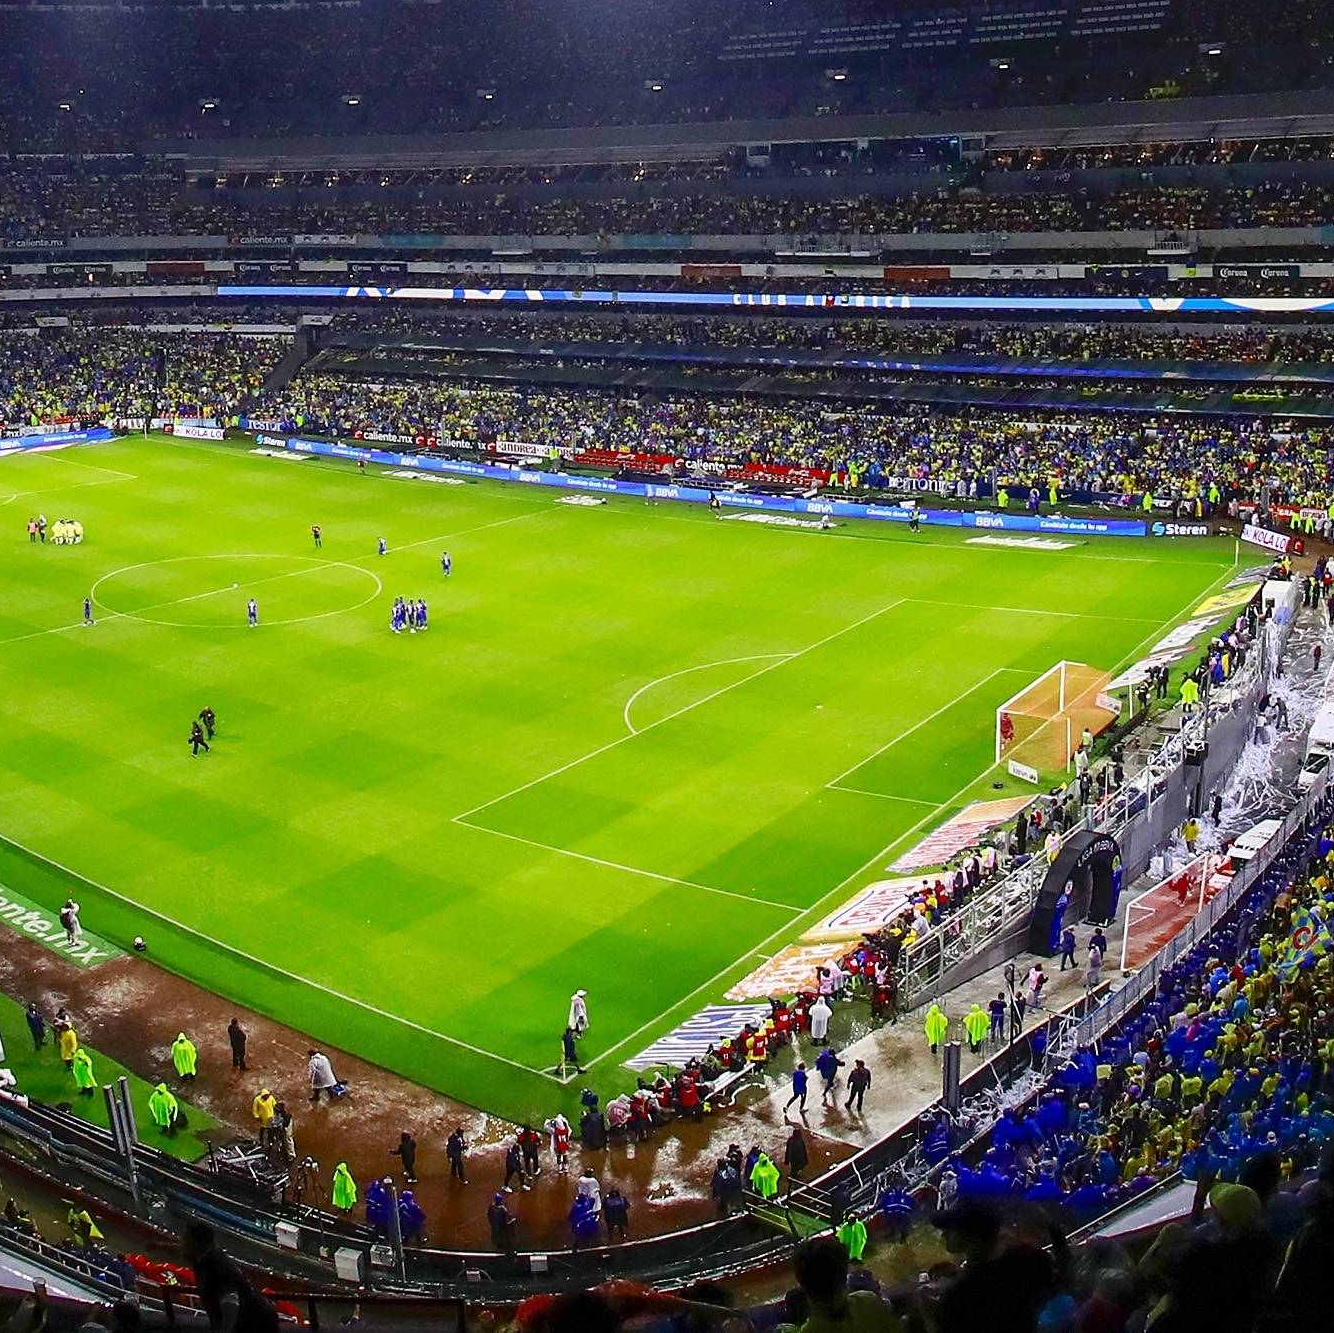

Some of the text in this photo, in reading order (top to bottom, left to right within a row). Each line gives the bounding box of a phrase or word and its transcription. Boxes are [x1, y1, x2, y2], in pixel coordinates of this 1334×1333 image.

[1219, 267, 1290, 279] Corona Corona
[733, 294, 788, 307] CLUB
[363, 432, 413, 445] caliente.mx
[519, 473, 541, 483] BBVA
[655, 487, 678, 498] BBVA
[807, 502, 833, 513] BBVA
[975, 516, 1004, 527] BBVA
[1165, 523, 1208, 535] Steren
[1252, 529, 1274, 545] KOLA
